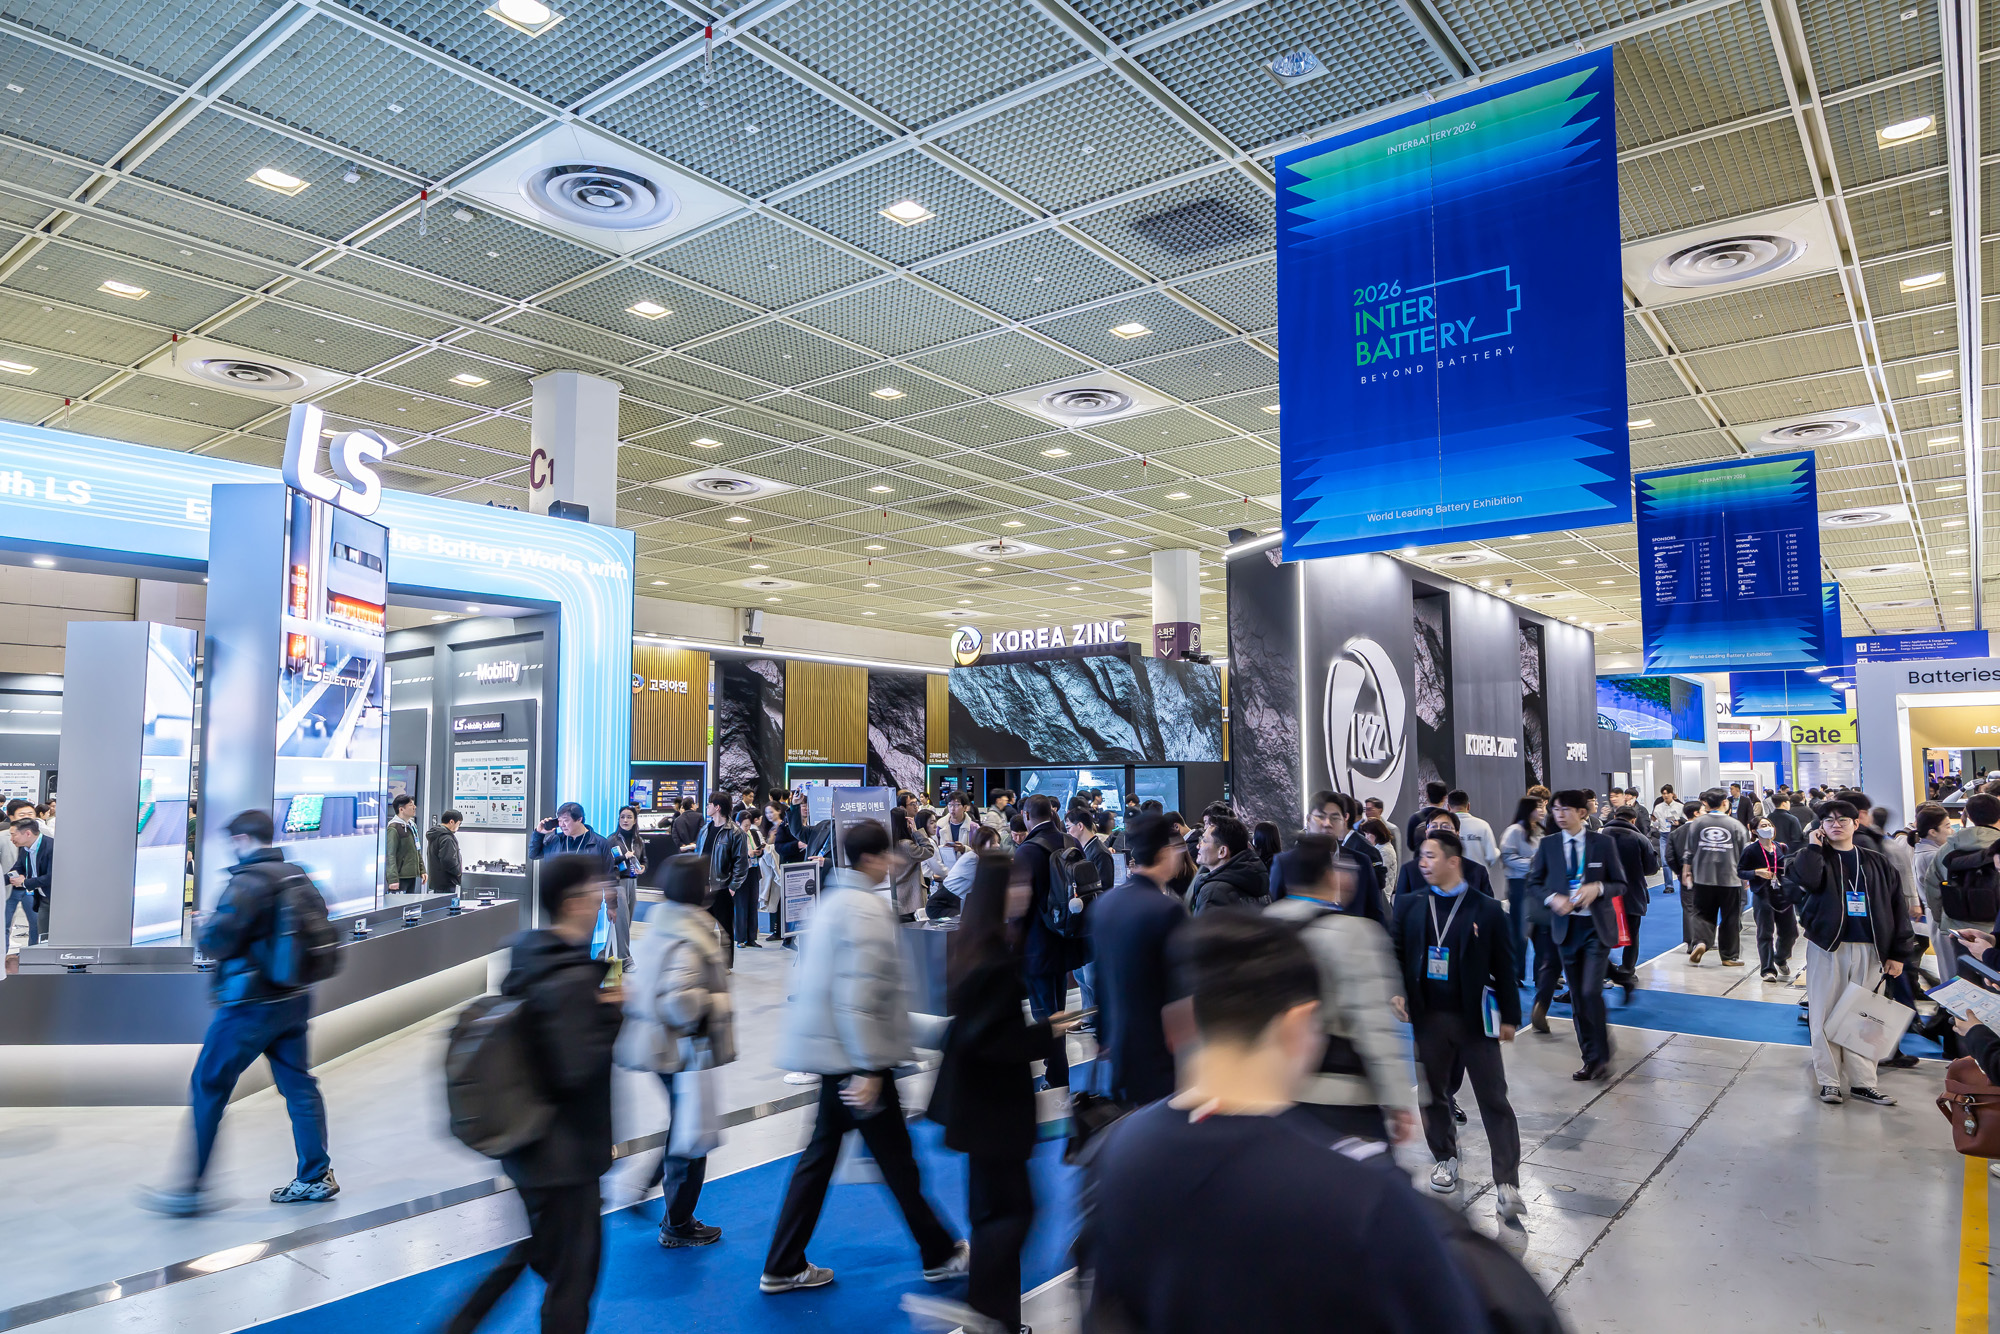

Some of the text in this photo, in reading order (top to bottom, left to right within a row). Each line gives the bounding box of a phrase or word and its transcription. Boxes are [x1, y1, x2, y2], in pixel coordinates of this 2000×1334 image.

[1353, 279, 1402, 306] 2026
[1355, 295, 1437, 336] INTER
[1356, 316, 1476, 366] BATTERY
[1361, 345, 1515, 384] BEYOND BATTERY
[530, 448, 555, 490] C1
[45, 476, 92, 505] LS
[185, 497, 211, 523] E
[1367, 495, 1523, 522] World Leading Battery Exhibition
[390, 528, 628, 581] he Battery Works with
[992, 620, 1127, 653] KOREA ZINC
[1157, 627, 1175, 636] 소화전
[303, 660, 365, 689] LS ELECTRIC
[477, 660, 520, 682] Mobility
[1909, 667, 2000, 684] Batteries
[649, 679, 688, 694] 고려아연
[1351, 713, 1386, 760] KZ
[1790, 725, 1841, 744] Gate
[1975, 726, 1989, 734] All
[1465, 733, 1518, 758] KOREA ZINC
[868, 801, 885, 812] 이벤트
